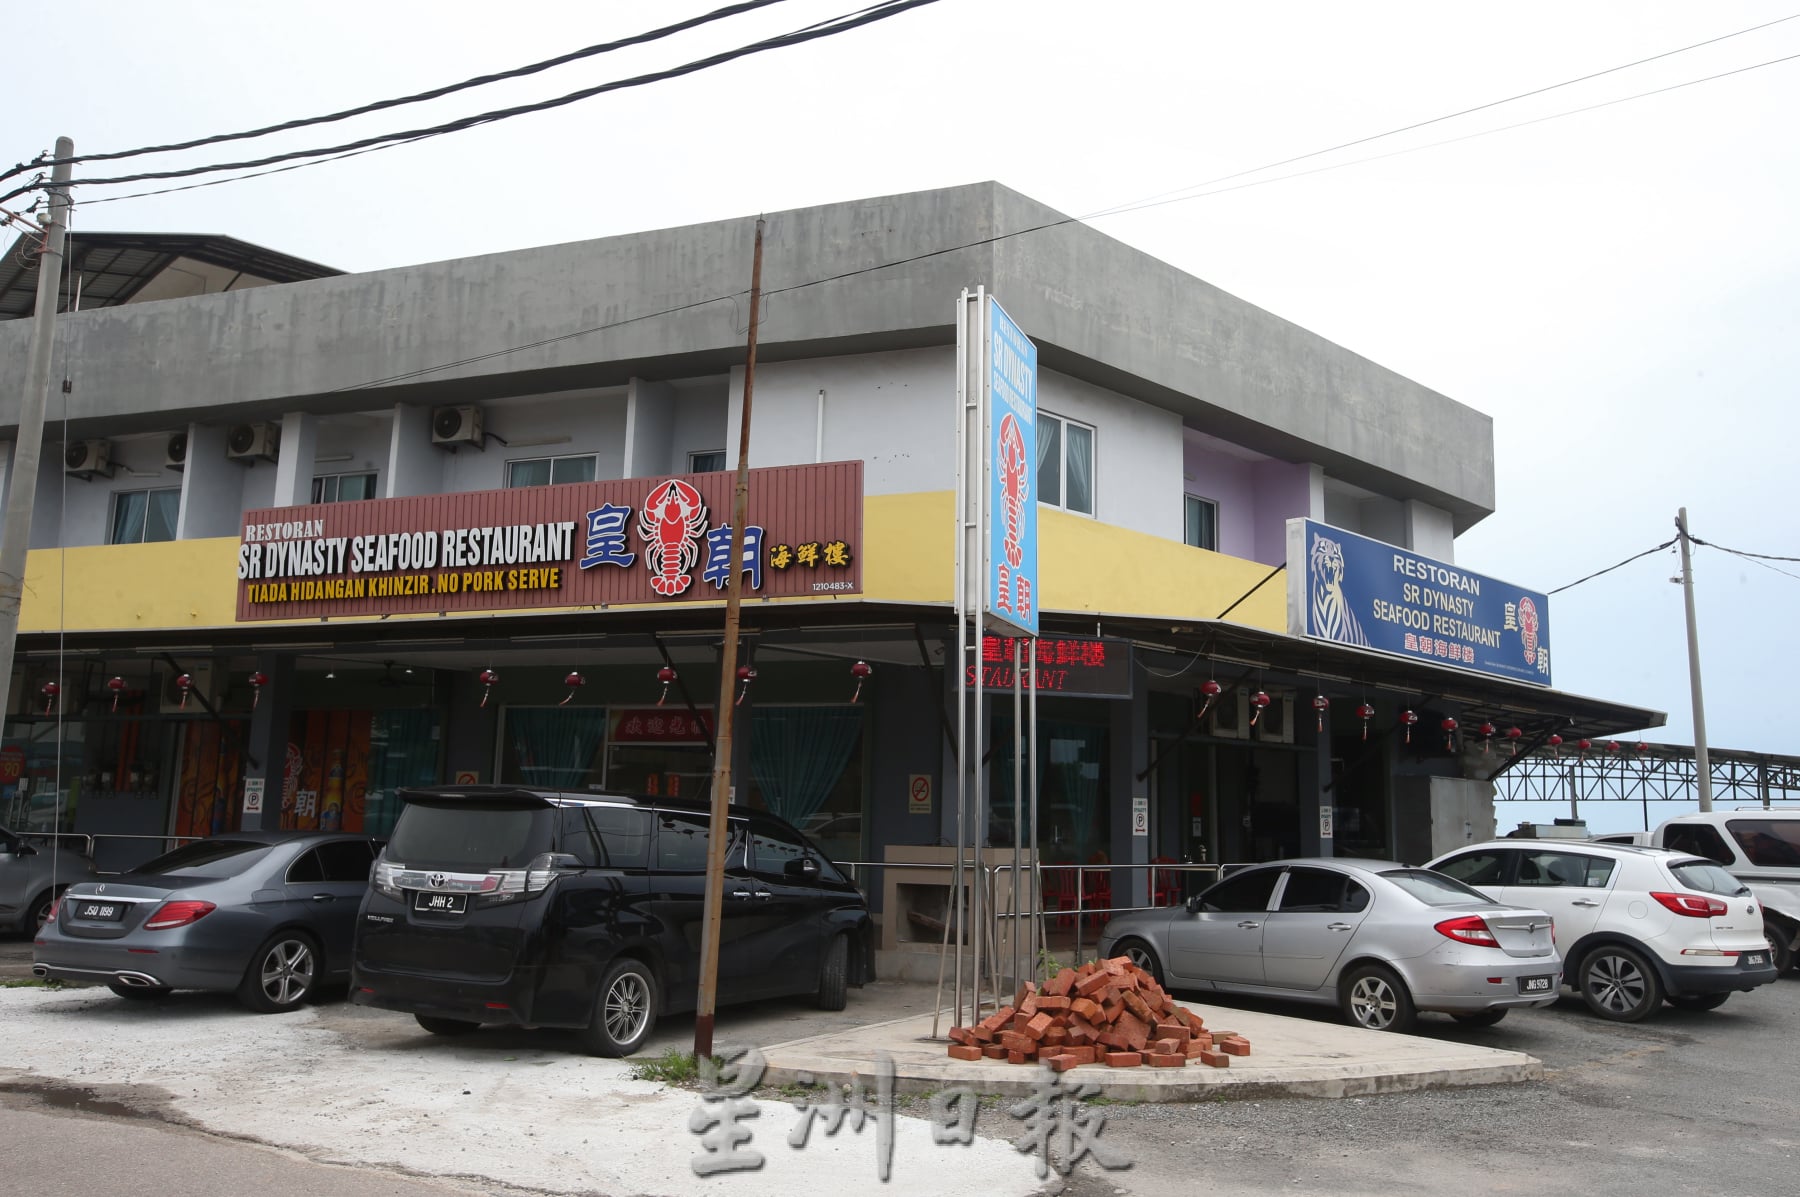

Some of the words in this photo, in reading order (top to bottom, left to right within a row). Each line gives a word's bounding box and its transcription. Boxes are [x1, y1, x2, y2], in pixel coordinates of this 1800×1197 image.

[245, 519, 324, 543] RESTORAN
[580, 503, 635, 570] 皇
[238, 543, 261, 580] SR
[265, 537, 348, 579] DYNASTY
[351, 531, 438, 574] SEAFOOD
[441, 521, 576, 568] RESTAURANT
[247, 582, 288, 604] TIADA
[290, 578, 365, 602] HIDANGAN
[462, 571, 505, 592] PORK
[508, 567, 560, 591] SERVE
[812, 582, 854, 591] 1210483-X
[1393, 554, 1480, 597] RESTORAN
[1403, 582, 1420, 603] SR
[1423, 588, 1474, 619] DYNASTY
[1373, 598, 1430, 631] SEAFOOD
[1433, 616, 1502, 649] RESTAURANT
[295, 788, 317, 819] 朝
[428, 896, 446, 908] JHH
[446, 896, 454, 908] 2
